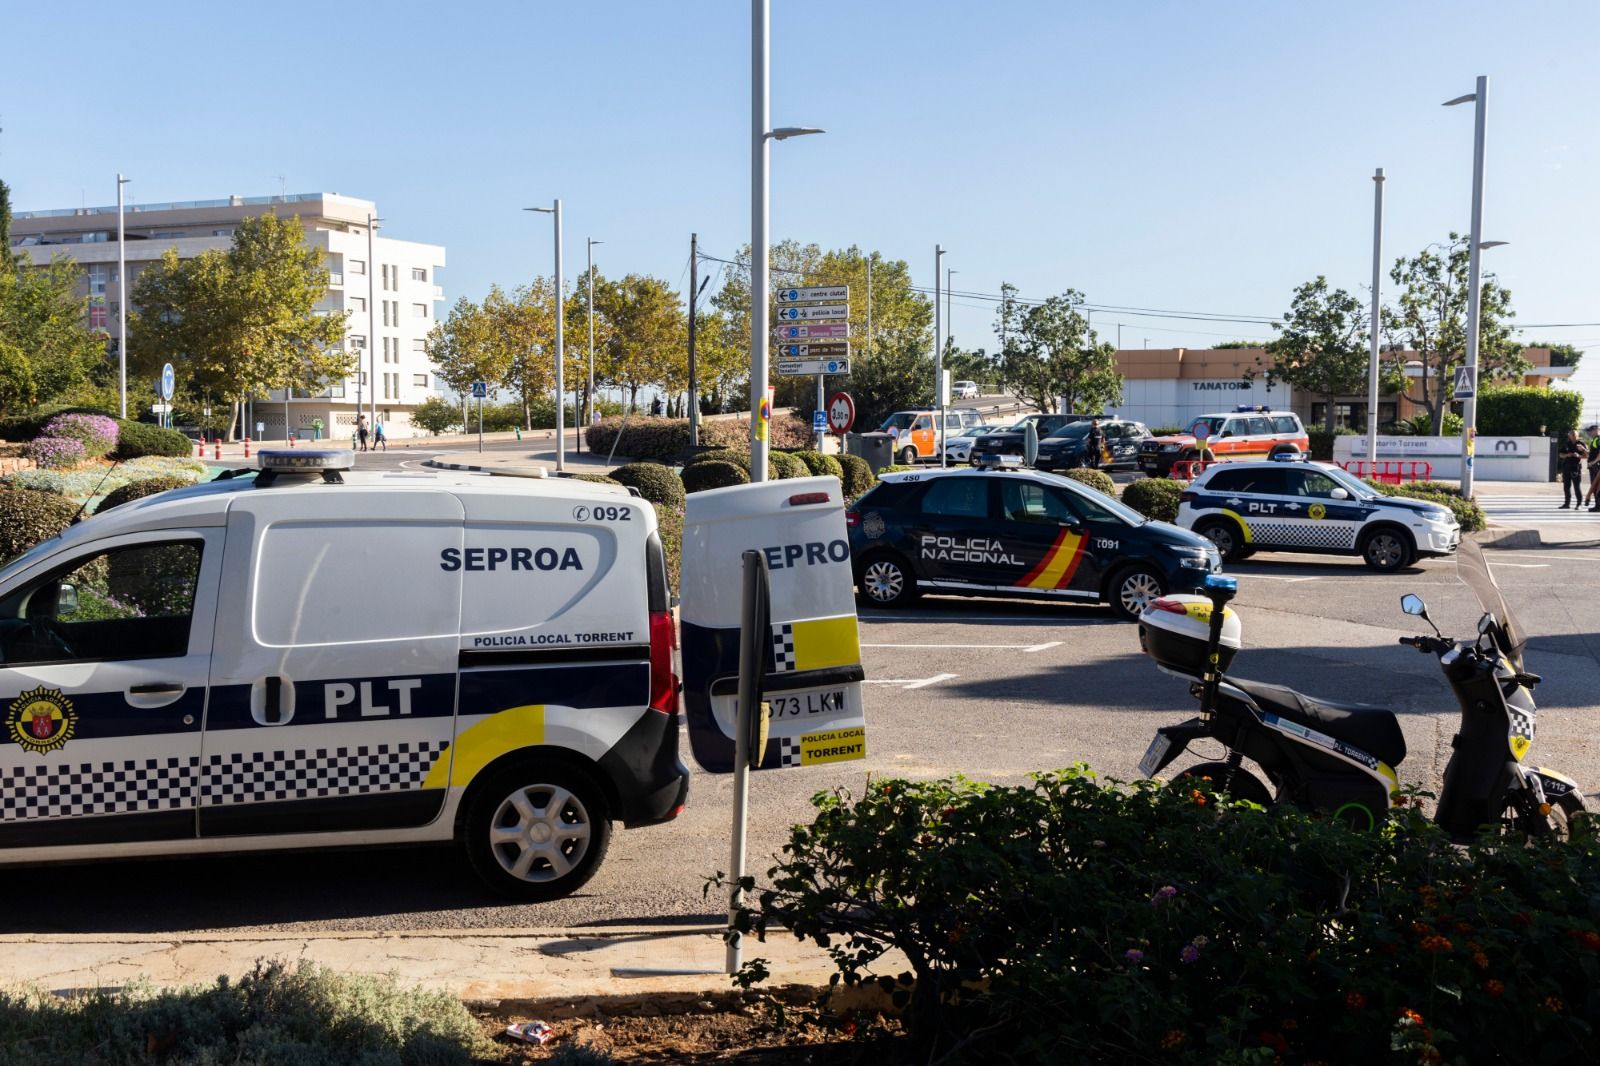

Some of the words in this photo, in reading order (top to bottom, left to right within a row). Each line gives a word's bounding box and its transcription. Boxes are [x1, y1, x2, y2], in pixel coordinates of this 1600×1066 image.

[1193, 382, 1250, 391] TANATOR
[593, 507, 631, 520] 092
[1249, 502, 1278, 514] PLT
[921, 535, 1004, 551] POLICÍA
[1101, 540, 1119, 549] 091
[440, 547, 583, 571] SEPROA
[763, 539, 850, 570] EPRO
[921, 548, 1025, 566] NACIONAL
[474, 637, 526, 647] POLICIA
[530, 634, 572, 644] LOCAL
[575, 631, 634, 642] TORRENT
[324, 679, 422, 719] PLT
[762, 698, 801, 719] 573
[807, 691, 844, 714] LKW
[802, 733, 836, 743] POLICIA
[838, 729, 865, 739] LOCAL
[806, 743, 863, 758] TORRENT
[1345, 747, 1369, 762] TORRENT
[1551, 781, 1566, 792] 112
